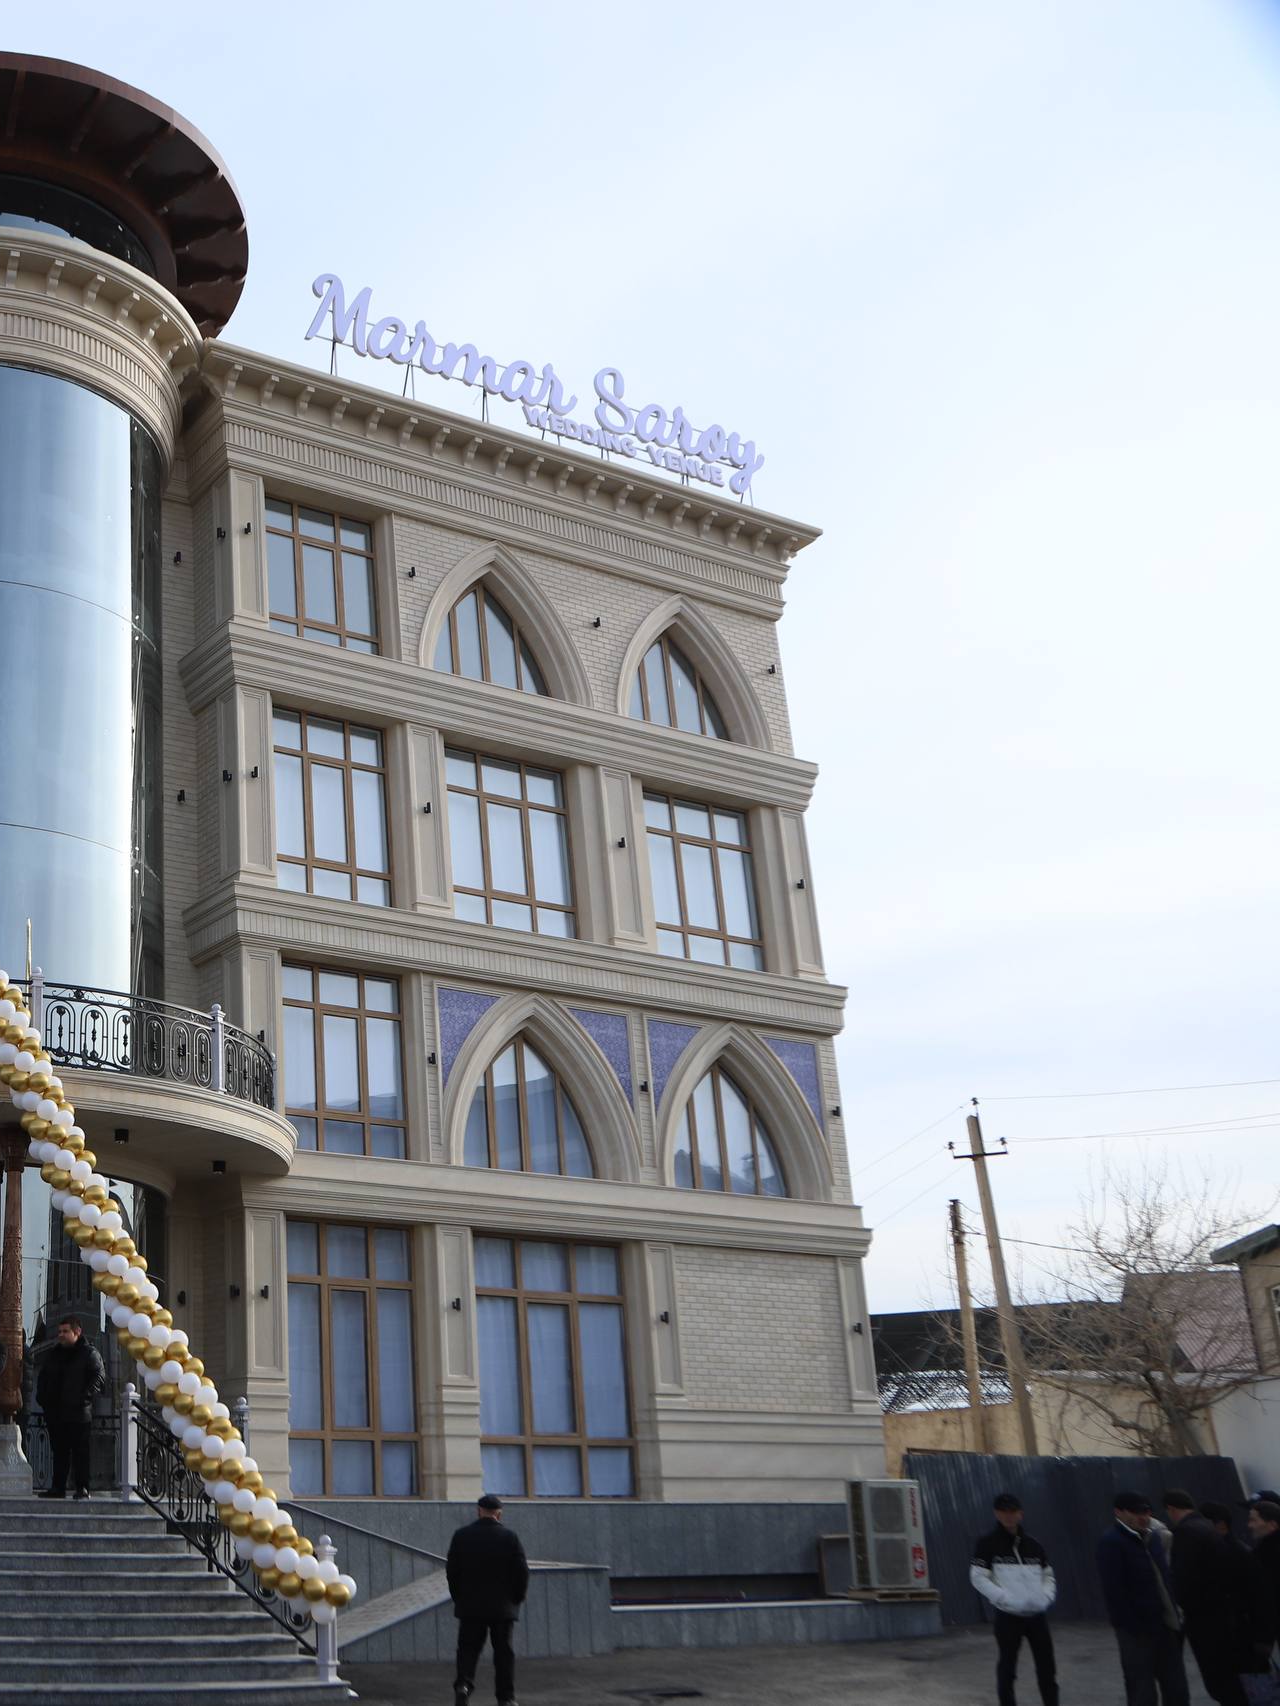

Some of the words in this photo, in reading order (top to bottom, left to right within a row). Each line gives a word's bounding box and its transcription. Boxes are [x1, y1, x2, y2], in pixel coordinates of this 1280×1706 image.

[304, 273, 577, 415] Marmar
[594, 367, 765, 495] Saroy
[522, 403, 637, 457] WEDDING
[646, 445, 725, 488] VENUE
